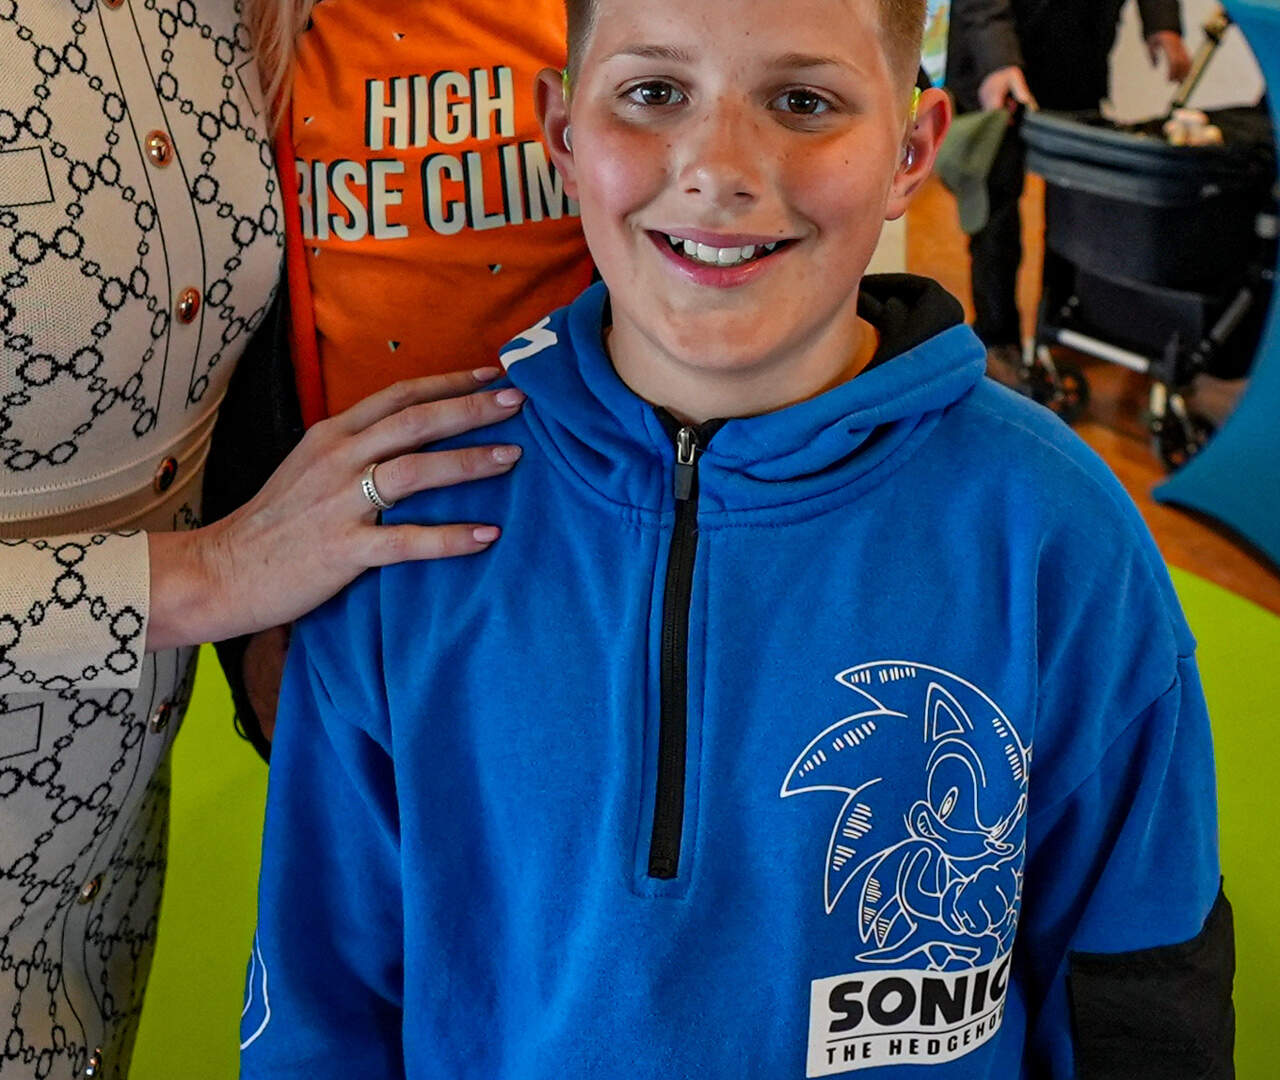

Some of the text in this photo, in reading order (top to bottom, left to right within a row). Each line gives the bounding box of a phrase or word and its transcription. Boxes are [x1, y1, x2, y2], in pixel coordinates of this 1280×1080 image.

[365, 66, 515, 151] HIGH
[828, 953, 1011, 1033] SONIC
[826, 1041, 872, 1065] THE
